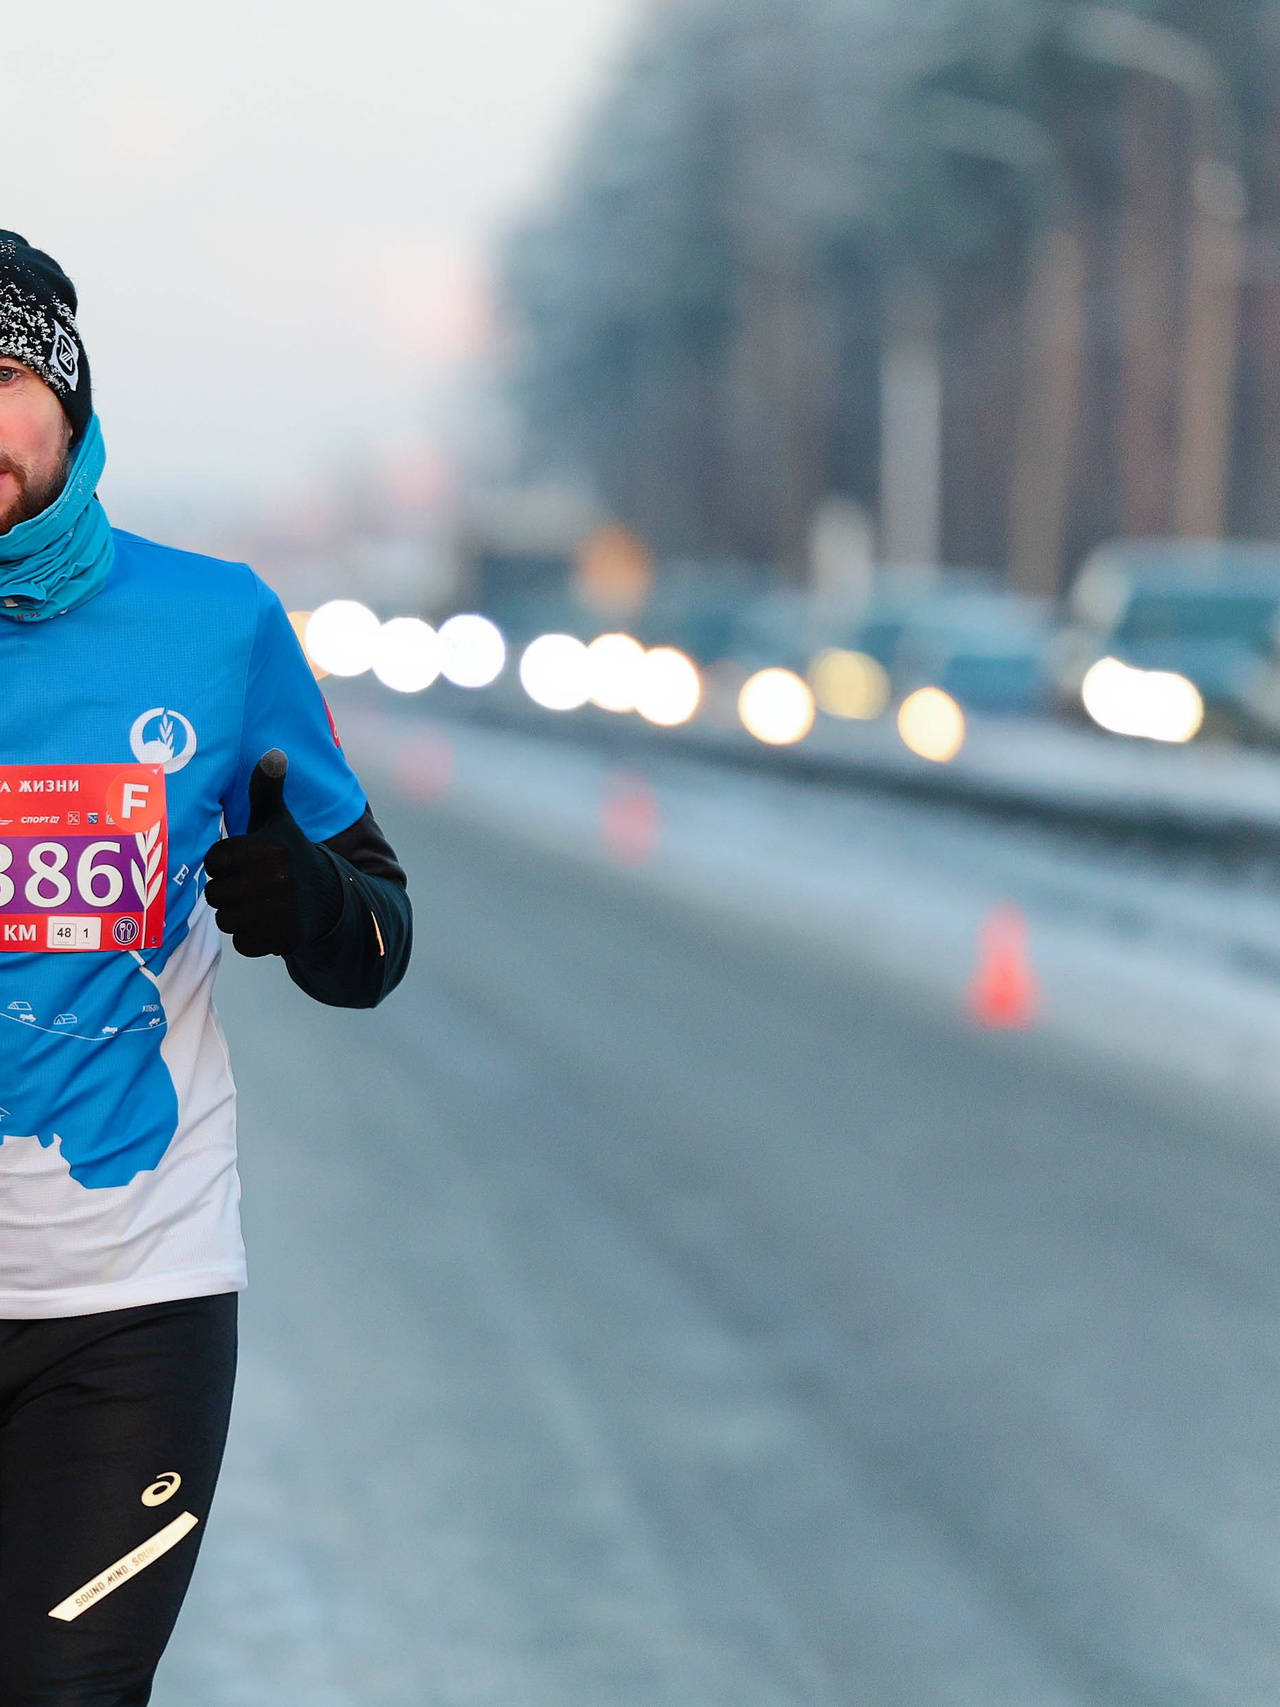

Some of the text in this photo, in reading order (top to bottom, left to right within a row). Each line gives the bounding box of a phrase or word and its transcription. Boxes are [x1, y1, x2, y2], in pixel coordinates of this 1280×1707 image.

[18, 779, 80, 793] ЖИЗНИ
[121, 782, 150, 819] F
[56, 927, 89, 939] 48 1
[74, 1581, 106, 1607] SOUND
[131, 1542, 160, 1567] SOUN
